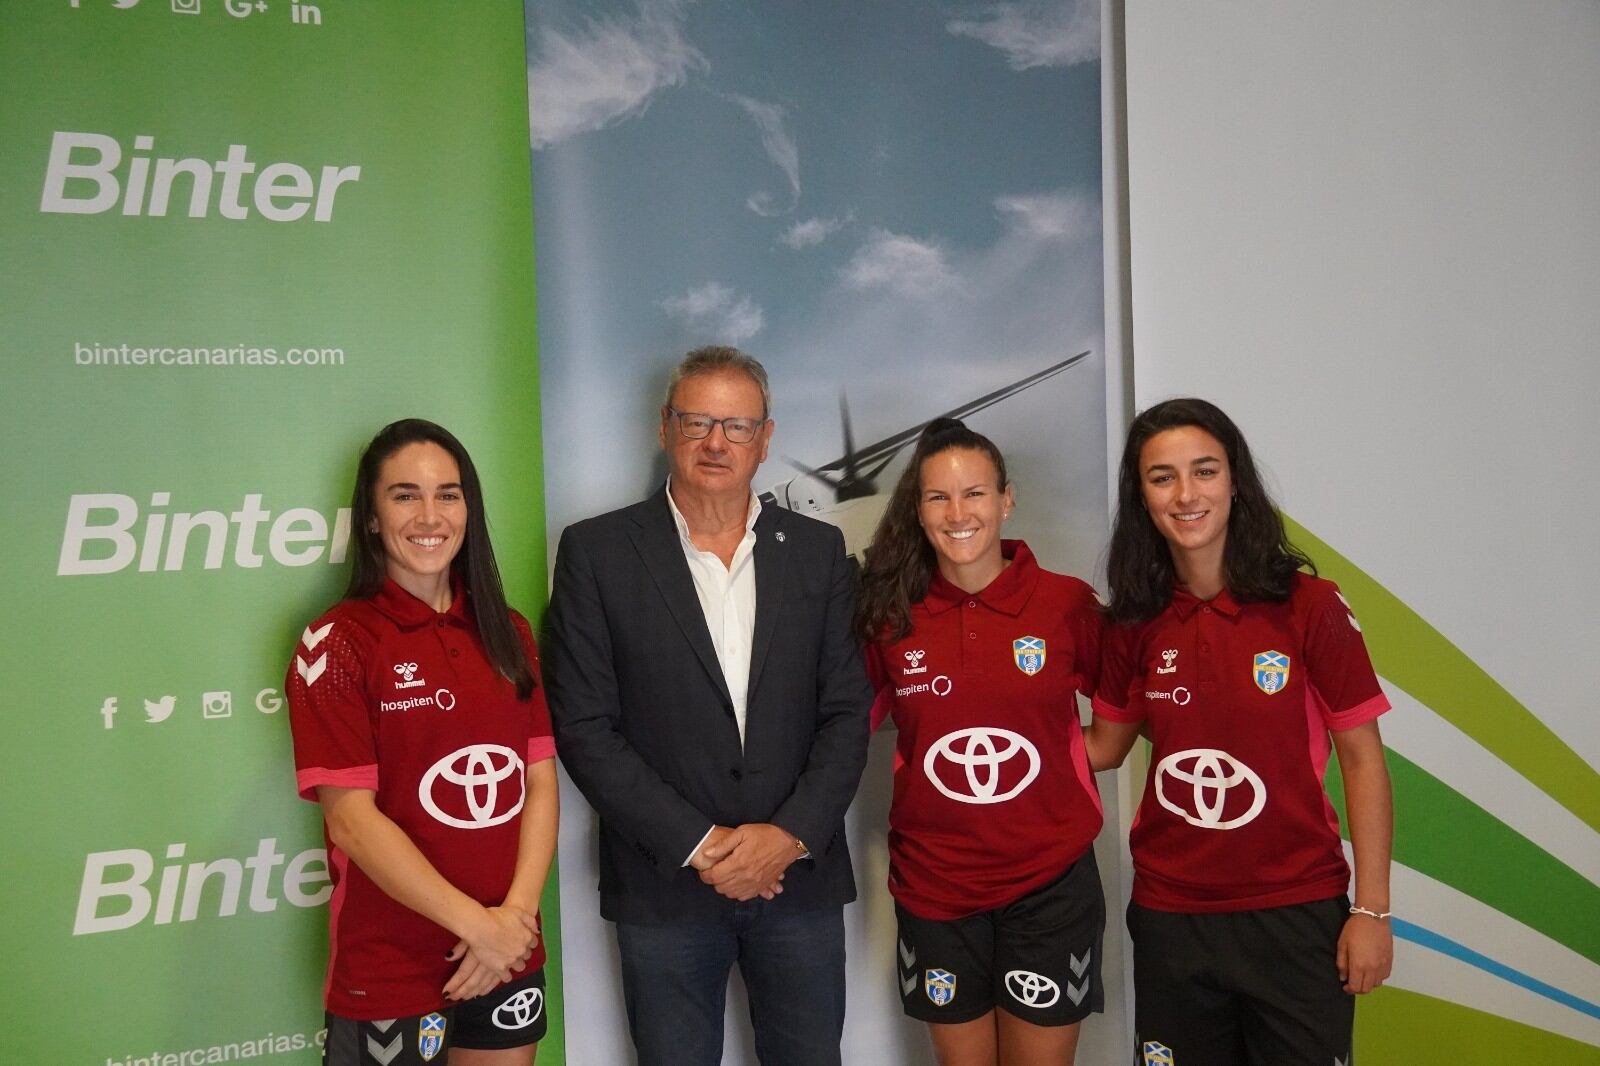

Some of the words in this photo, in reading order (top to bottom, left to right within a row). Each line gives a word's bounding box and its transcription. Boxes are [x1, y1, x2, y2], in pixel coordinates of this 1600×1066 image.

[40, 131, 361, 221] Binter
[75, 342, 345, 365] bintercanarias.com
[903, 665, 927, 676] hummel
[1156, 665, 1177, 674] huel
[395, 678, 425, 690] hummel
[1145, 691, 1171, 700] ospiten
[380, 696, 434, 711] hospiten
[72, 838, 335, 935] Binte
